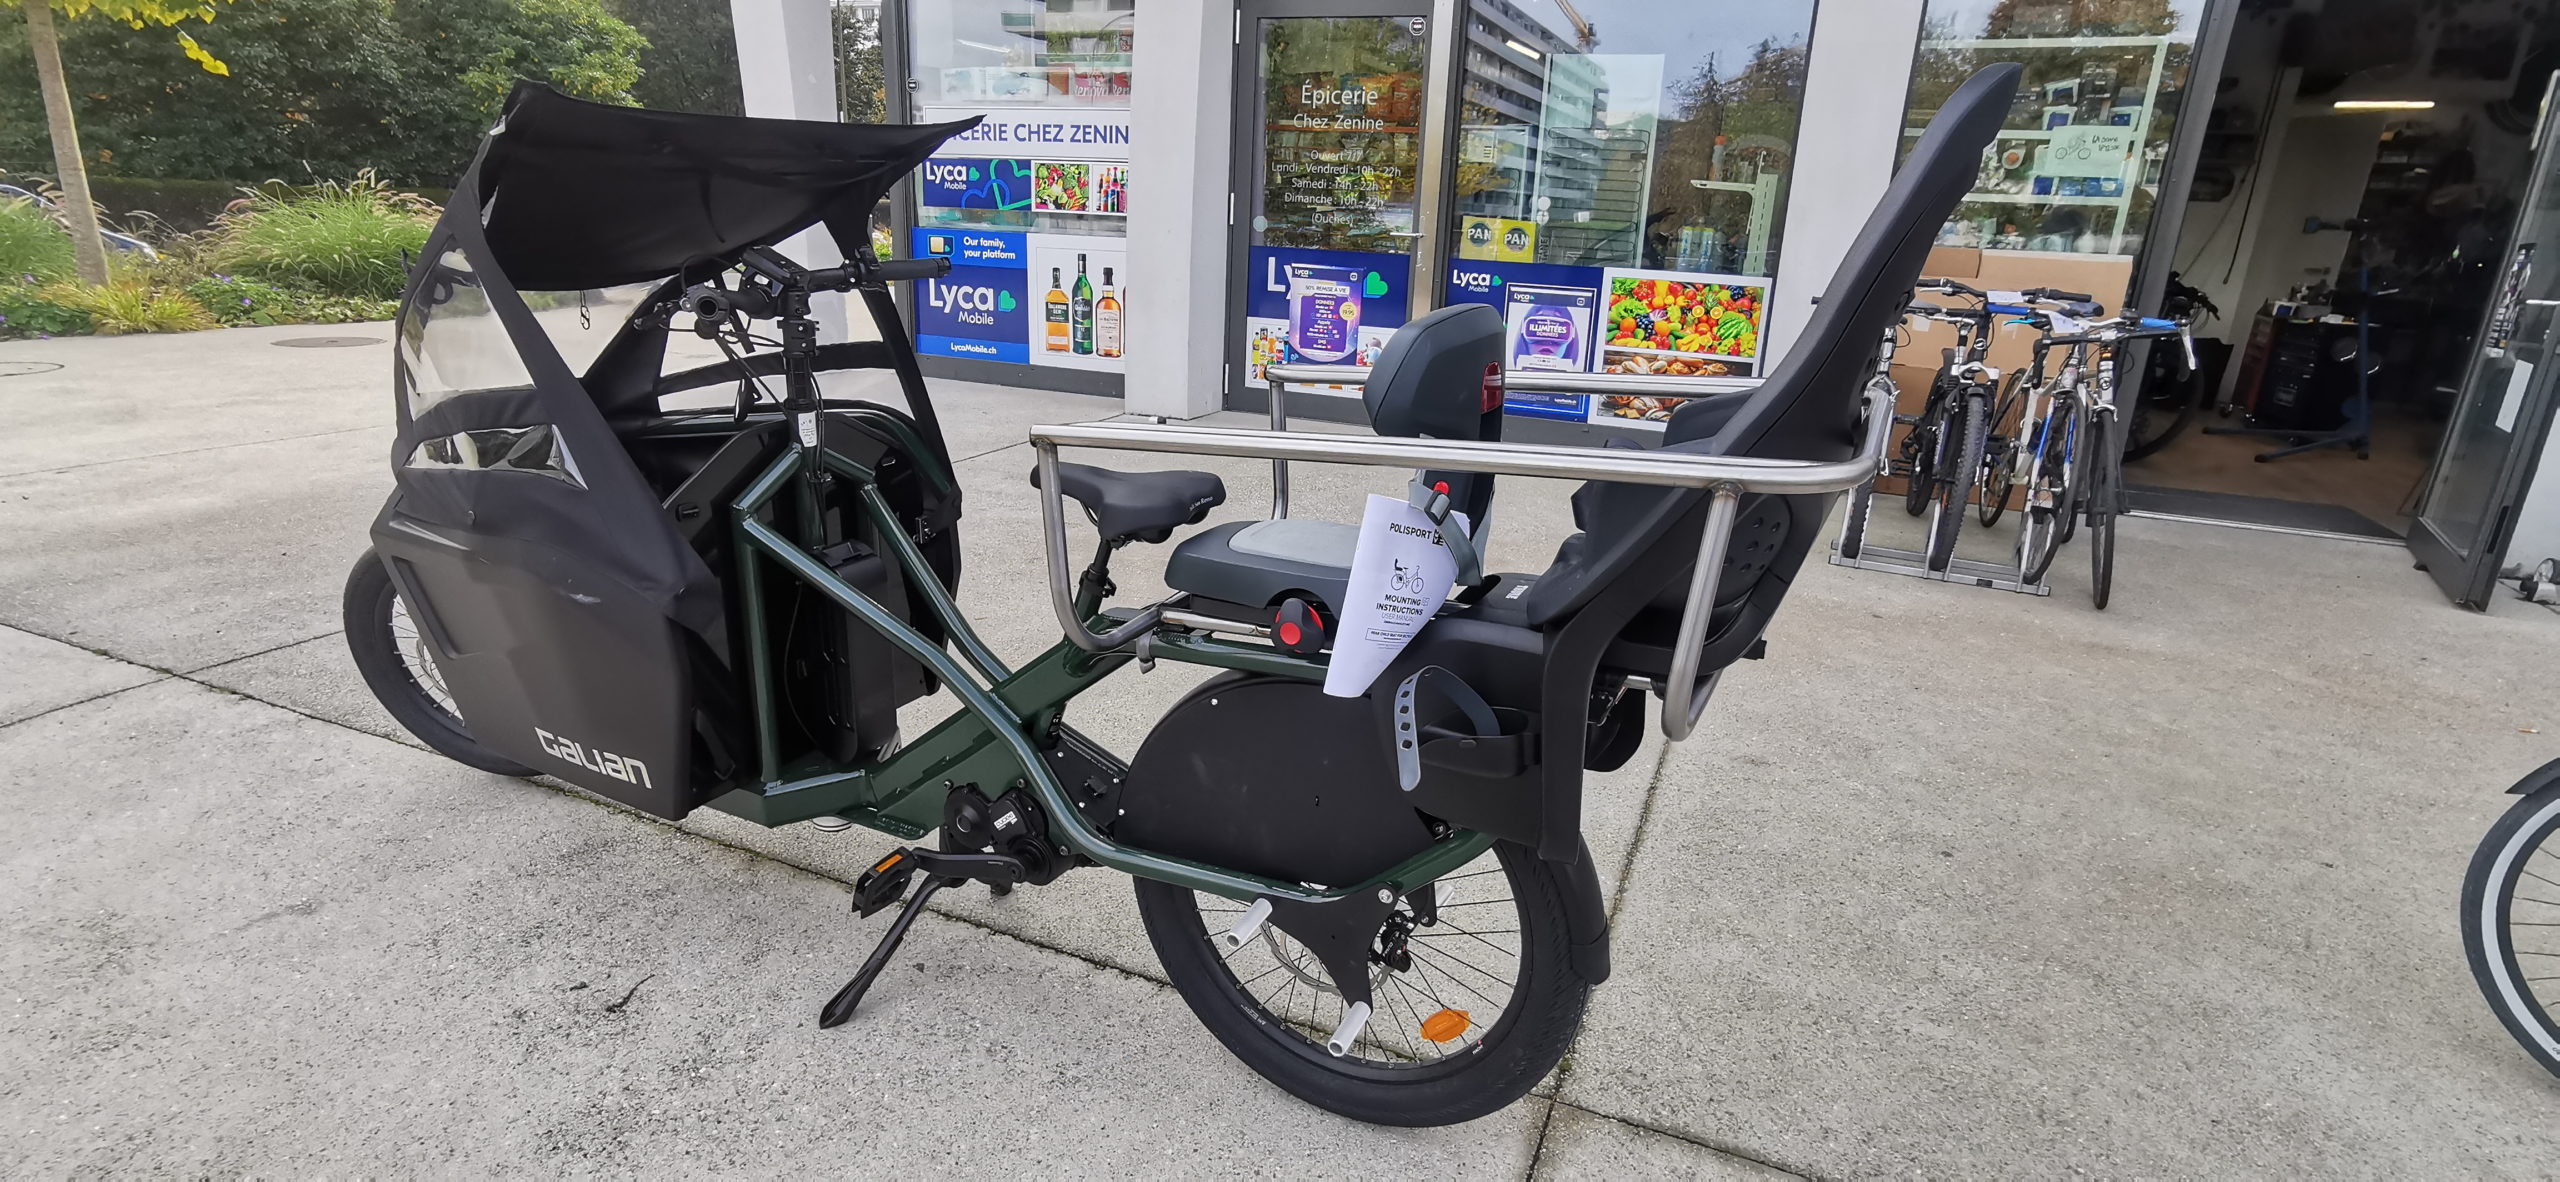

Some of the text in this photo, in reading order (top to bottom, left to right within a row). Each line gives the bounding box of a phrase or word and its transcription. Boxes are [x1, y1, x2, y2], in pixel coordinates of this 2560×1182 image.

[1301, 79, 1379, 109] Épicerie
[1293, 114, 1384, 130] Chez Zenine
[953, 123, 1008, 142] CERIE
[1014, 123, 1064, 142] CHEZ
[1310, 150, 1343, 161] Ouvert
[926, 161, 967, 184] Lyca
[1271, 163, 1298, 172] Lundi
[1305, 163, 1349, 174] Vendredi
[1357, 165, 1374, 175] 10h
[1383, 167, 1401, 177] 22h
[944, 182, 967, 190] Mobile
[1292, 178, 1327, 189] Samedi
[1335, 180, 1352, 189] 14h
[1360, 180, 1378, 190] 22h
[1284, 192, 1333, 204] Dimanche
[1340, 195, 1357, 206] 10h
[1365, 196, 1384, 207] 22h
[964, 236, 1005, 249] Our family,
[964, 250, 1016, 260] your platform
[1452, 269, 1490, 287] Lyca
[928, 277, 994, 313] Lyca
[1468, 285, 1489, 293] Mobile
[958, 311, 994, 325] Mobile
[950, 342, 997, 354] LycaMobile.ch
[1390, 523, 1432, 539] POLISPORT
[1385, 594, 1421, 606] MOUNTING
[1376, 603, 1423, 615] INSTRUCTIONS
[1396, 614, 1414, 622] MANUAL
